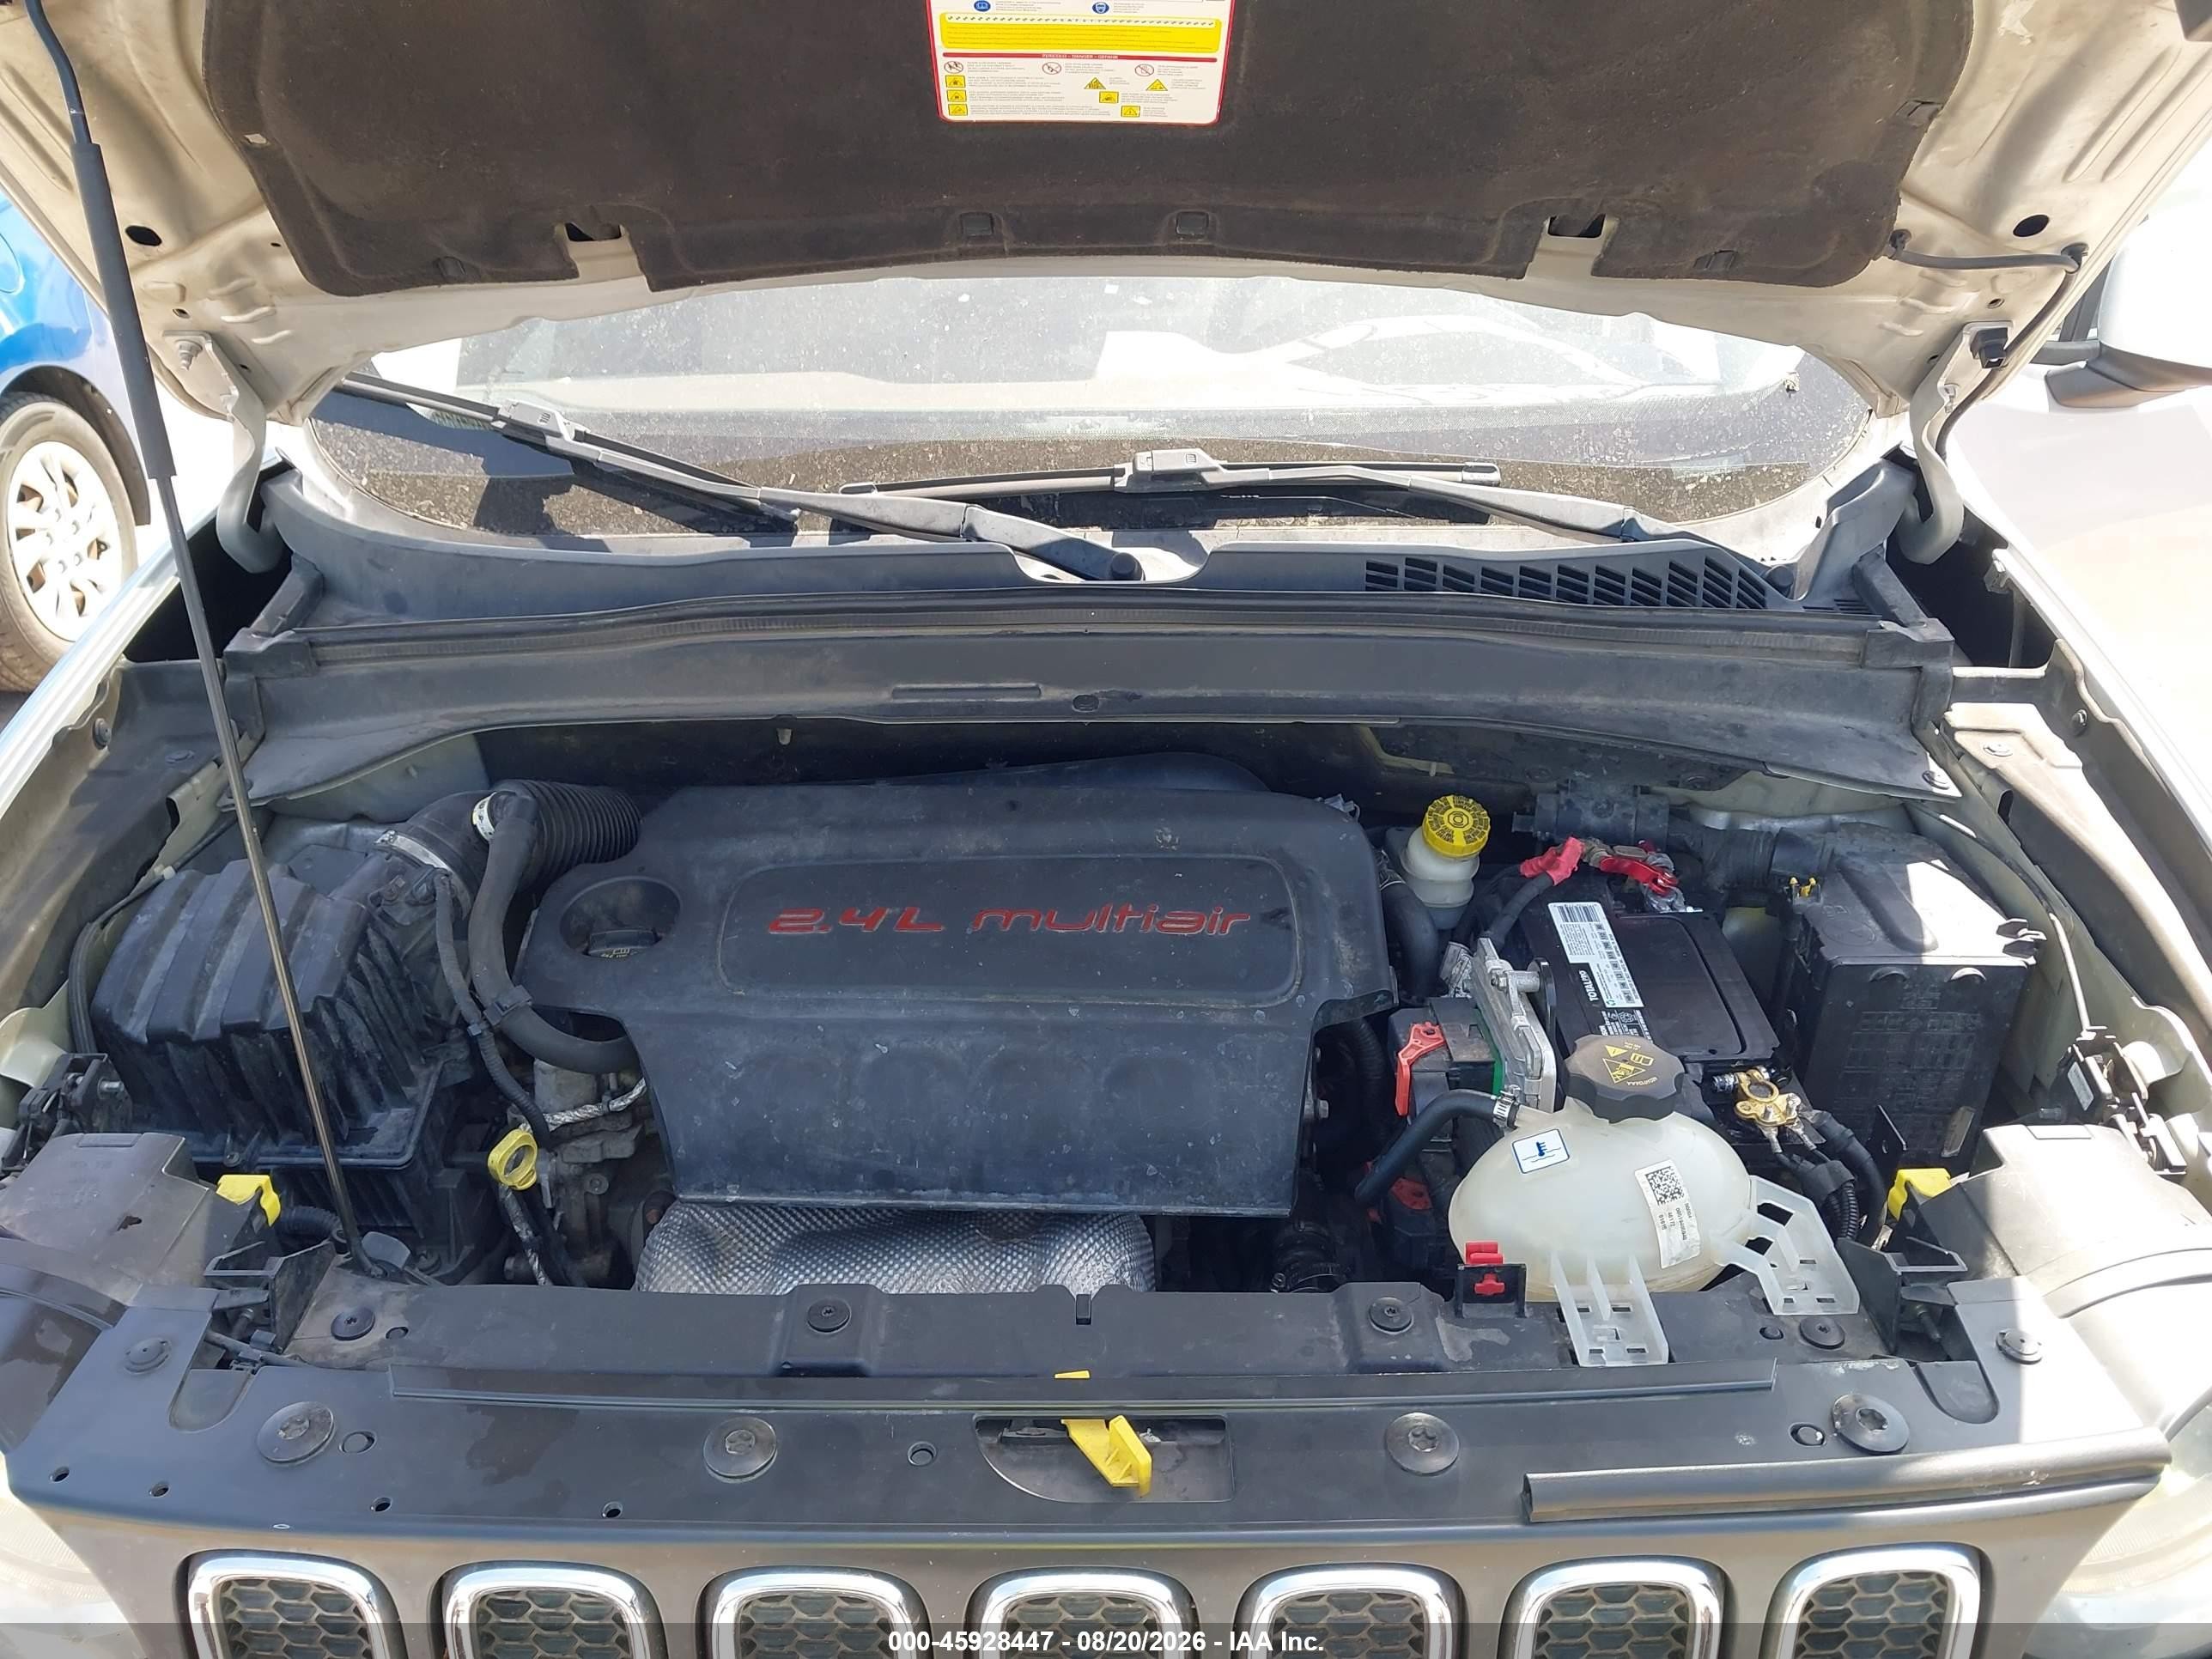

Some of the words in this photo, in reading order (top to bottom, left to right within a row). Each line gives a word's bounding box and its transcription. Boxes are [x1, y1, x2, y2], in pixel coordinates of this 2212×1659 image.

[768, 906, 945, 933] 2.4L
[972, 902, 1251, 935] multiair
[1578, 969, 1599, 1002] TOTALPRO
